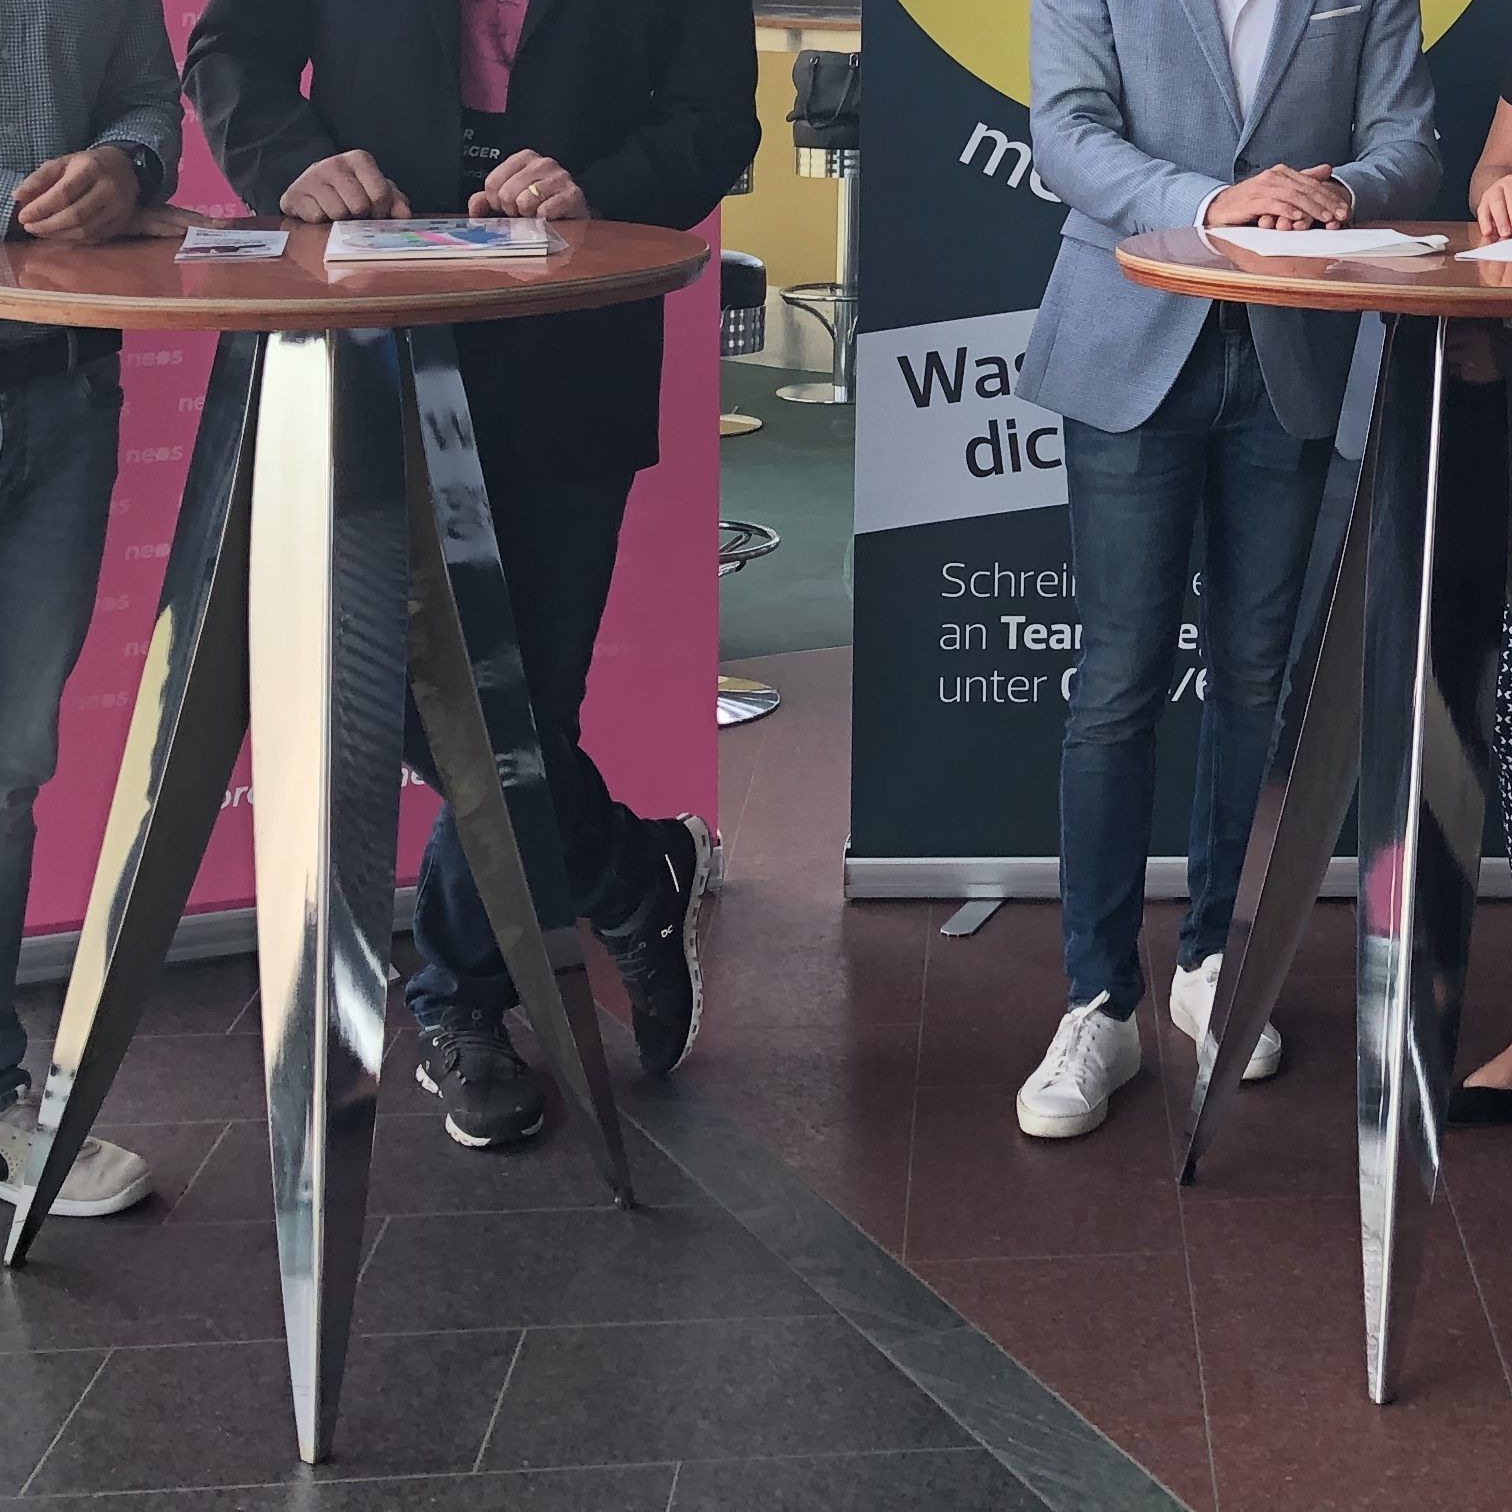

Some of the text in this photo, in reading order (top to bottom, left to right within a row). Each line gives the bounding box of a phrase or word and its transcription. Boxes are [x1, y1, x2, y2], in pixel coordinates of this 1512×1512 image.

[965, 418, 1063, 479] dic
[941, 561, 1077, 598] Schrei
[939, 623, 988, 650] an
[938, 669, 1049, 703] unter
